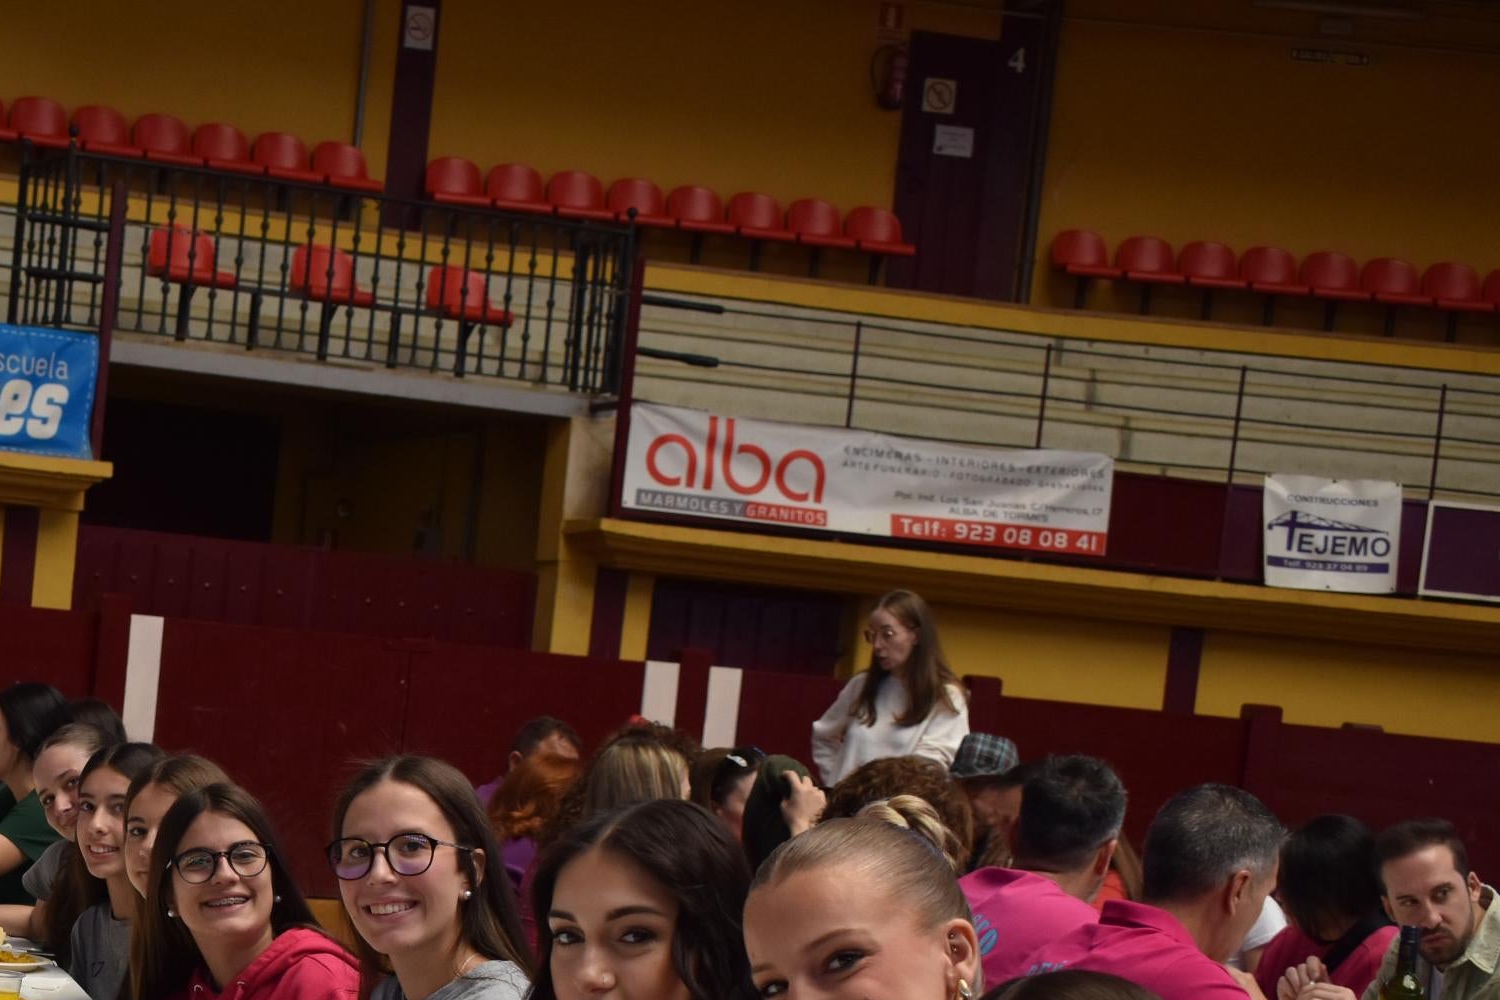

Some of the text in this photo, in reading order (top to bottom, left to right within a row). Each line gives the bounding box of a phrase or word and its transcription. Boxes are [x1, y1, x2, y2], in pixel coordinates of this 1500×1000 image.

[1008, 47, 1026, 73] 4
[646, 416, 826, 504] alba
[639, 492, 826, 526] MARMOLES Y GRANITOS
[900, 518, 1097, 551] Telf: 923 08 08 41
[1279, 514, 1391, 557] TEJEMO
